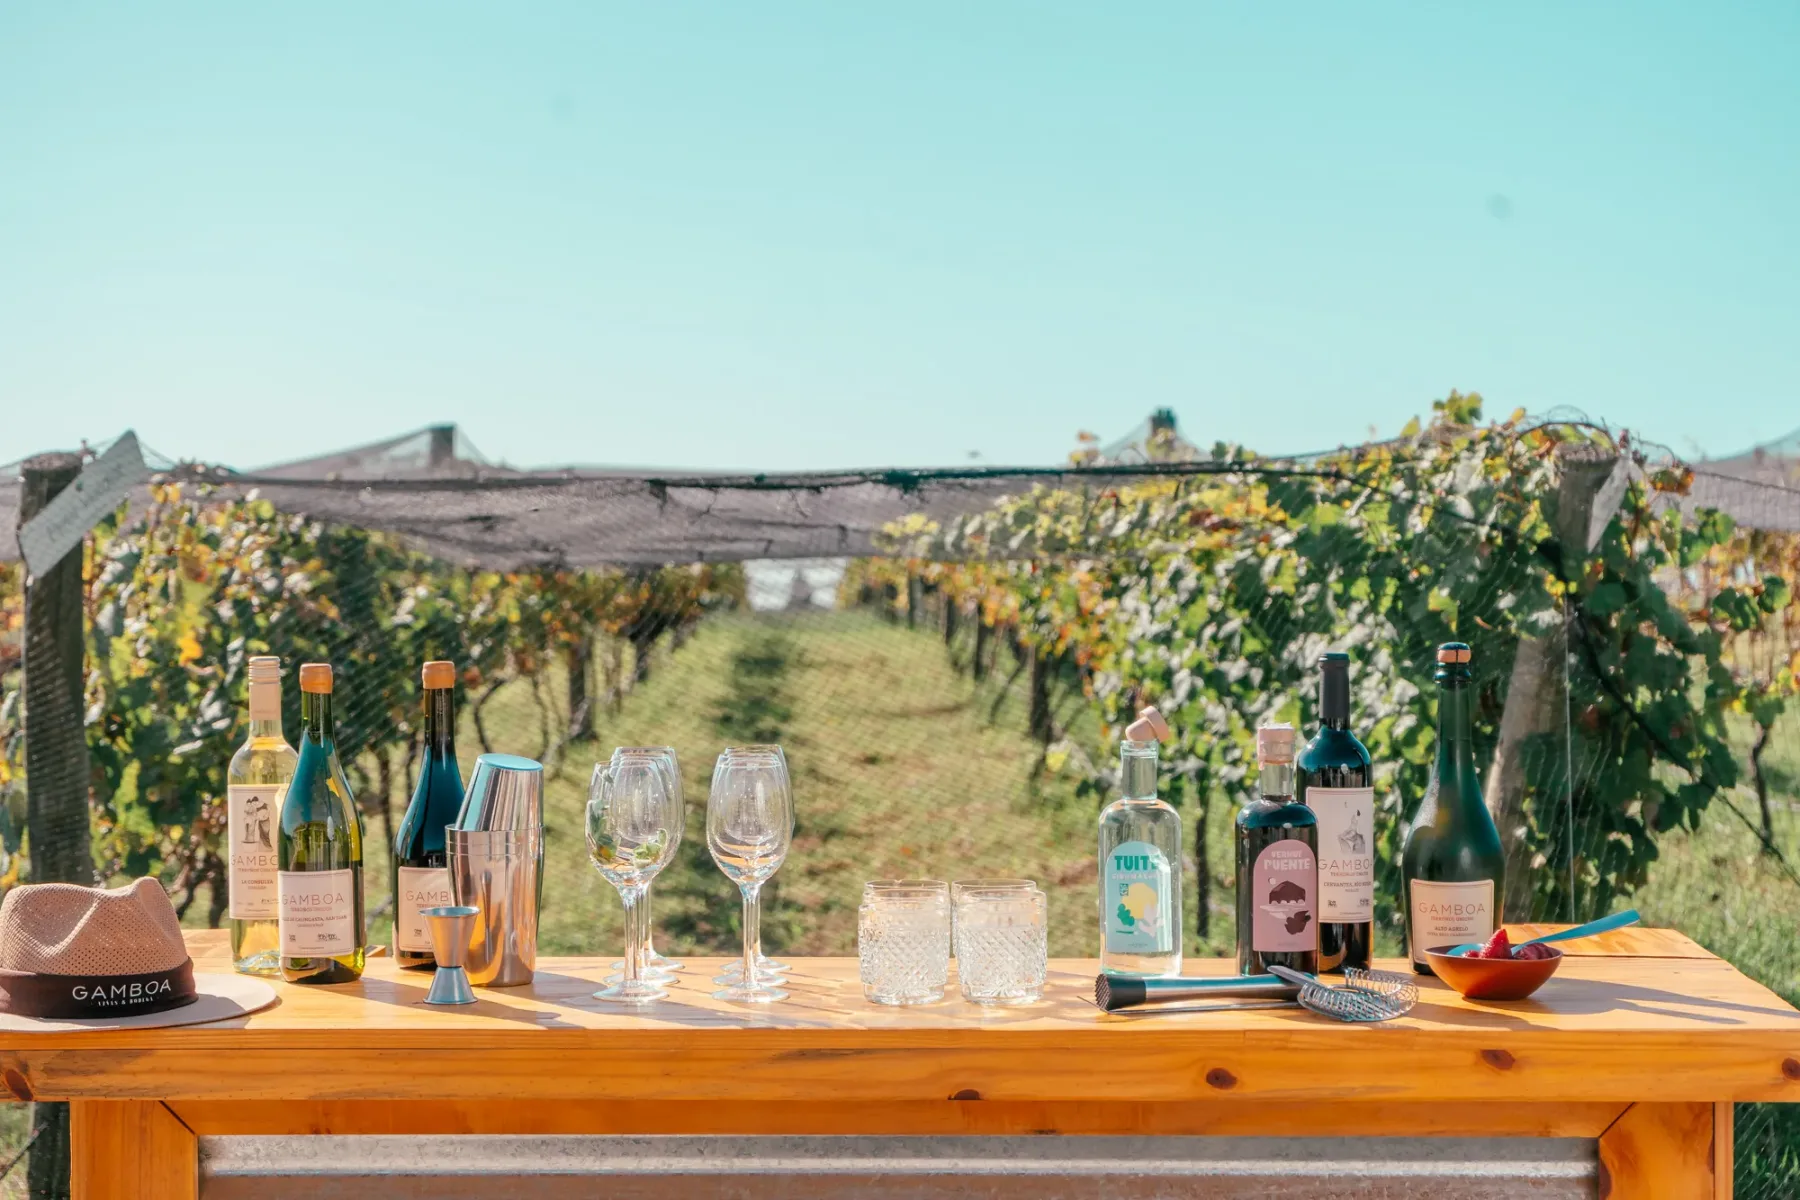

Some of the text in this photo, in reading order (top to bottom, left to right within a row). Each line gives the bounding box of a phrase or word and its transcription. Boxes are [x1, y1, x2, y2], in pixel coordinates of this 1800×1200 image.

[231, 855, 279, 866] GAMBO
[1263, 859, 1311, 870] PUENTE
[1319, 859, 1372, 870] GAMBO
[282, 893, 344, 905] GAMBOA
[405, 891, 451, 901] GAMB
[1418, 902, 1485, 915] GAMBOA
[72, 979, 172, 1000] GAMBOA
